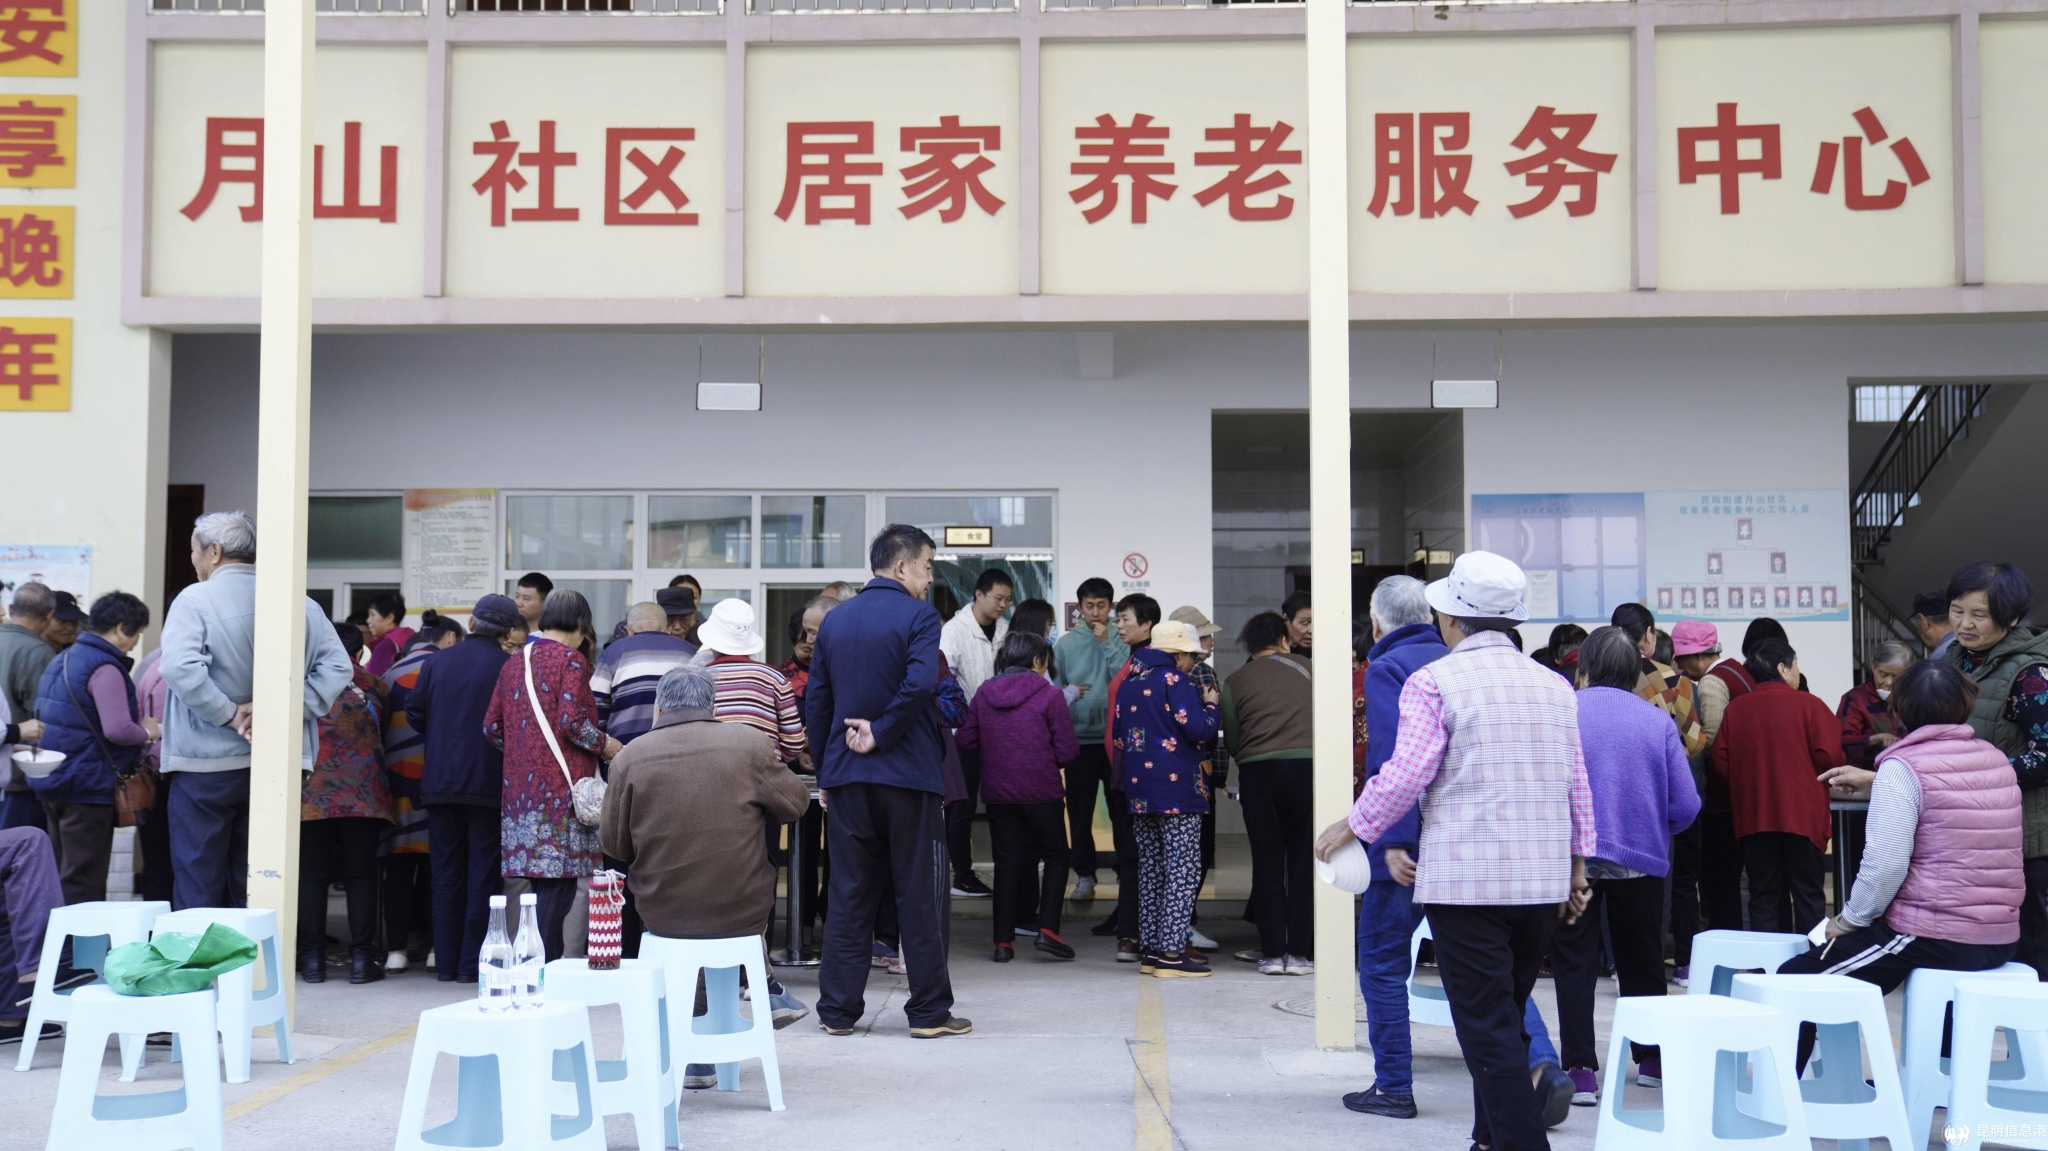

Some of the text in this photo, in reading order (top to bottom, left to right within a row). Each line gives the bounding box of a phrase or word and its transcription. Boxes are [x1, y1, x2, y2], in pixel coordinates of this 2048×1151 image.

[179, 102, 1931, 227] 月山社区居家养老服务中心
[1679, 505, 1810, 515] 居家养老服务中心工作人员
[967, 532, 983, 541] 食堂
